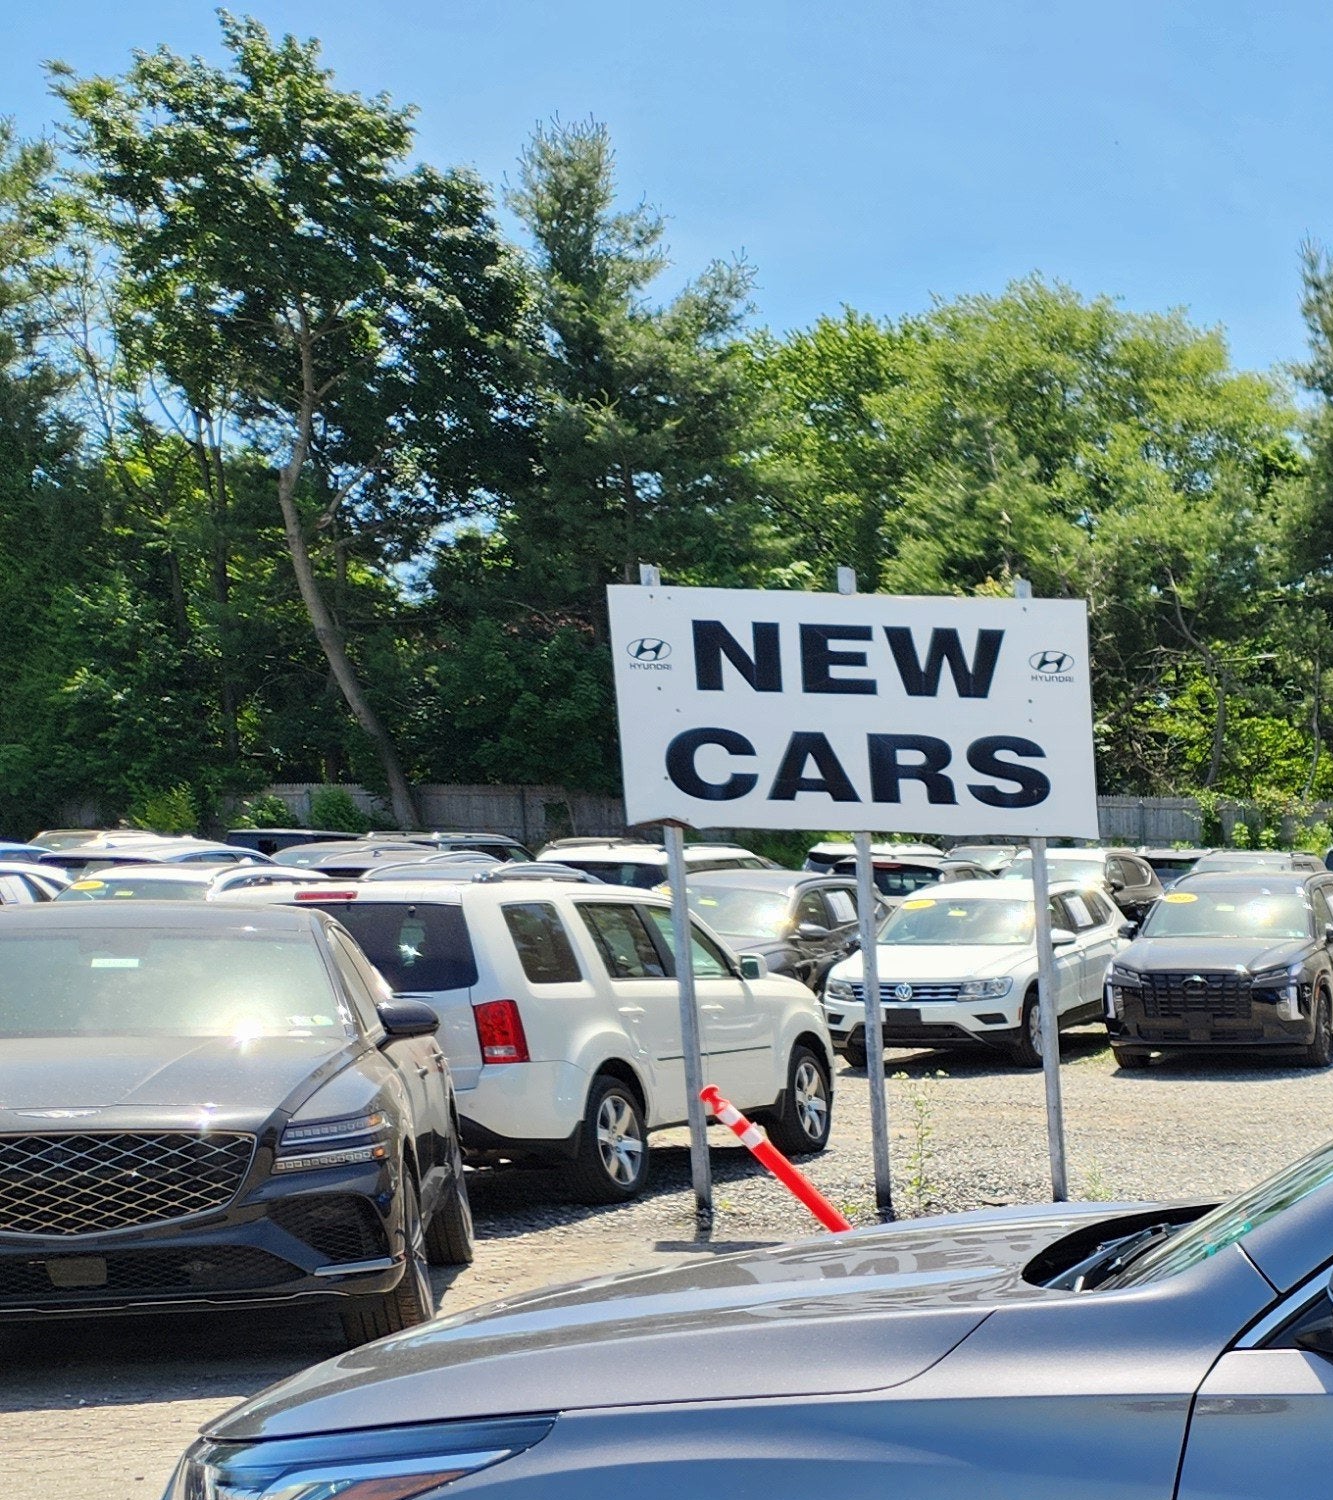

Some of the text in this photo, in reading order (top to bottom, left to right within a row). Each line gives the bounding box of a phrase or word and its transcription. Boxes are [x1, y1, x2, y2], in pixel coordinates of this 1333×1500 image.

[629, 662, 672, 671] HYUNDAI
[692, 619, 1005, 698] NEW
[1031, 674, 1074, 683] HYUNDAI
[665, 727, 1051, 808] CARS
